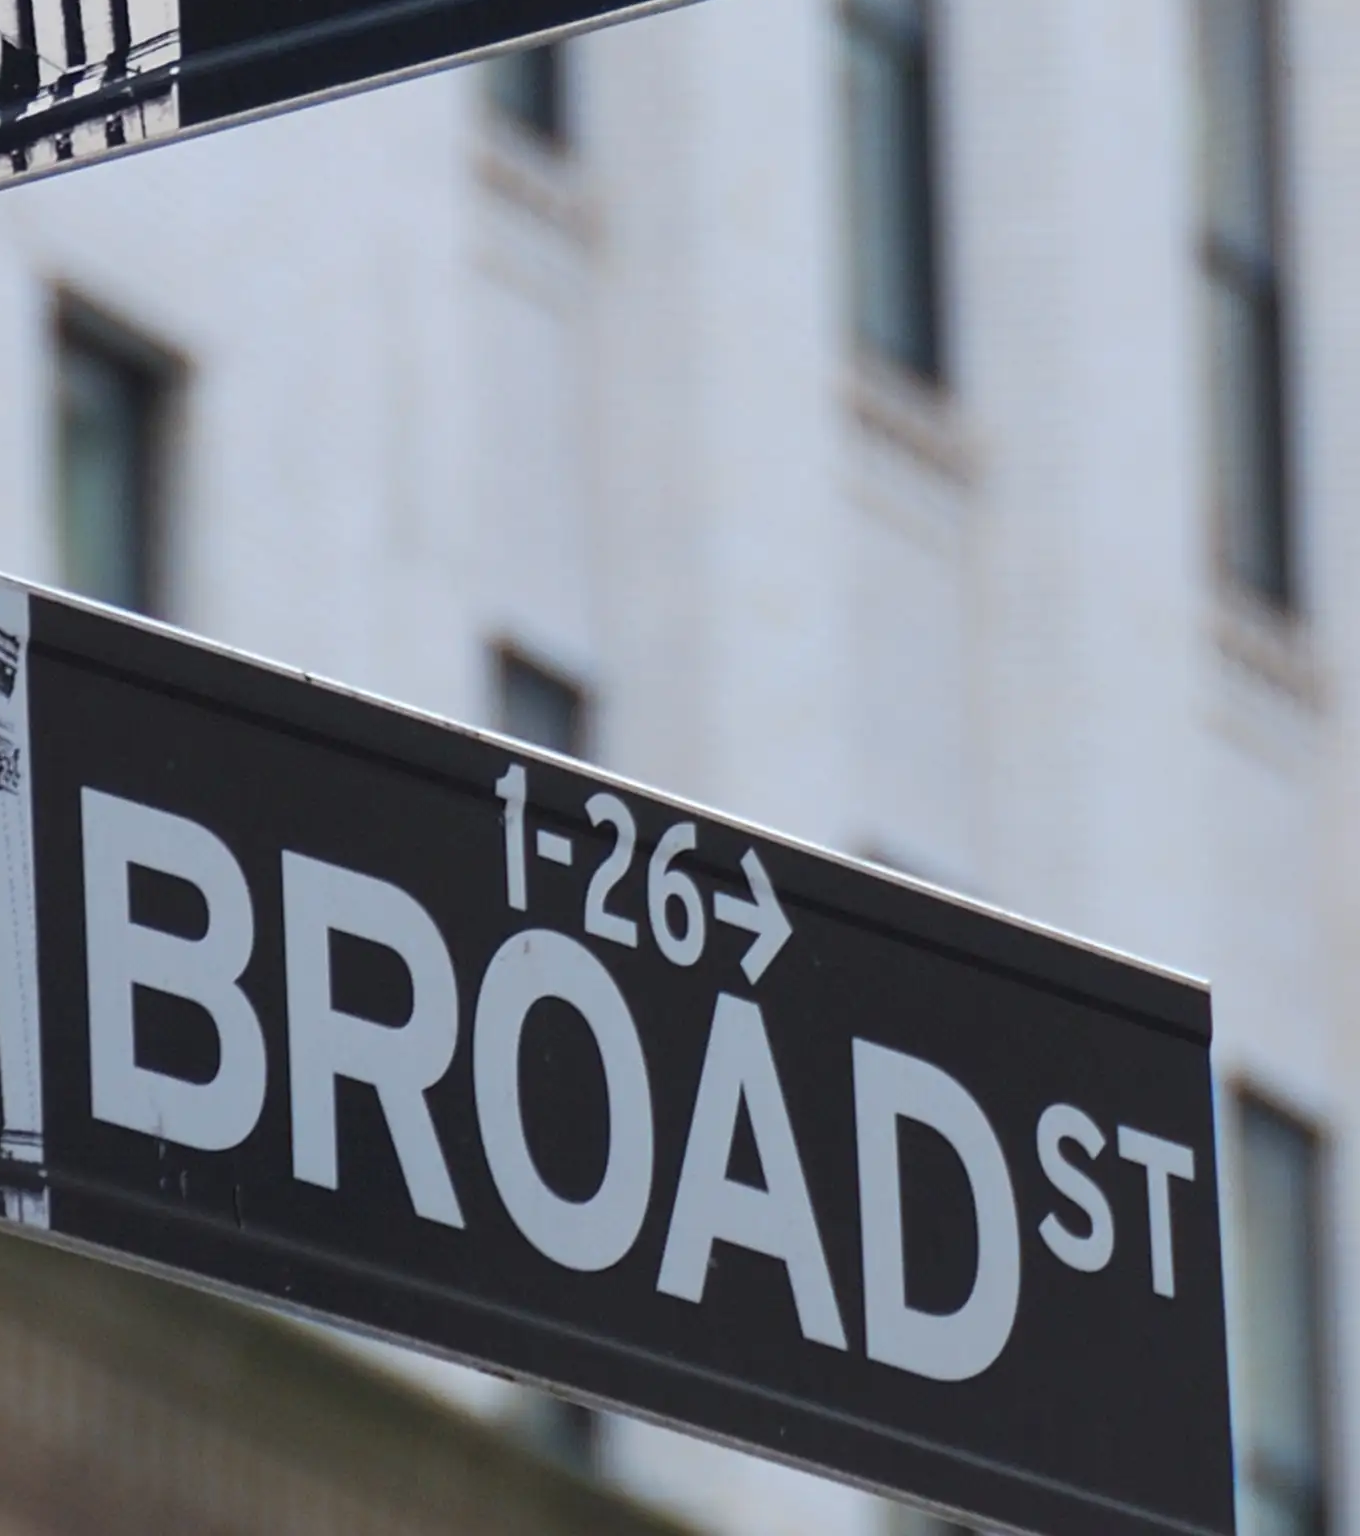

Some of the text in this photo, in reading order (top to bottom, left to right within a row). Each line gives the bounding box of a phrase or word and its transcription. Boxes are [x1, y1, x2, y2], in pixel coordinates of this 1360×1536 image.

[496, 763, 706, 966] 1-26
[81, 786, 1195, 1381] BROAD ST
